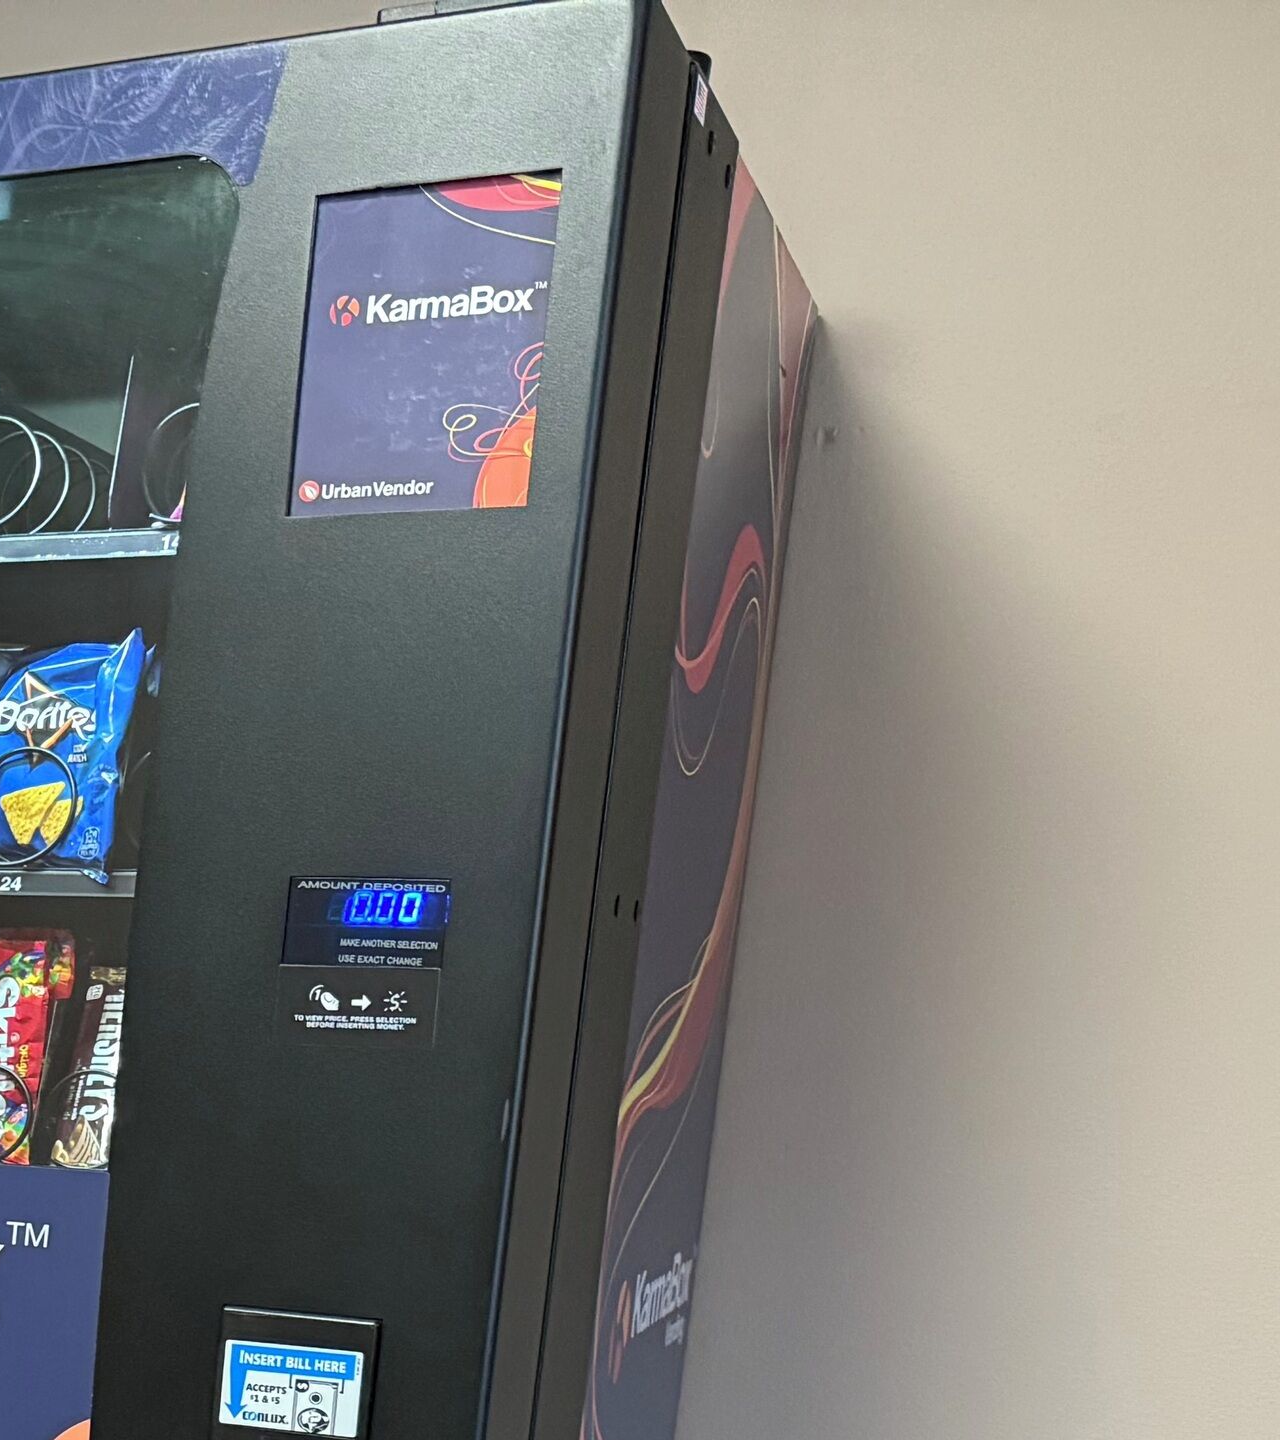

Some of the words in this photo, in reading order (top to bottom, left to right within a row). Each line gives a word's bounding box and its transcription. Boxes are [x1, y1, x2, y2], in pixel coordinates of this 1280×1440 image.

[366, 285, 533, 324] KarmaBox
[321, 480, 433, 499] UrbanVendor
[0, 876, 22, 892] 24
[297, 880, 358, 890] AMOUNT
[362, 882, 446, 893] DEPOSITED
[349, 891, 422, 924] 0.00
[340, 938, 360, 947] MAKE
[361, 939, 396, 948] ANOTHER
[398, 941, 438, 950] SELECTION
[338, 955, 355, 963] USE
[357, 956, 385, 964] EXACT
[387, 956, 423, 966] CHANGE
[336, 1022, 375, 1030] INSERTING
[6, 1220, 51, 1248] TM
[239, 1350, 283, 1368] INSERT
[286, 1356, 312, 1370] BILL
[314, 1359, 347, 1374] HERE
[246, 1383, 287, 1394] ACCEPTS
[250, 1394, 260, 1403] $1
[261, 1395, 269, 1404] &
[271, 1396, 280, 1404] $5
